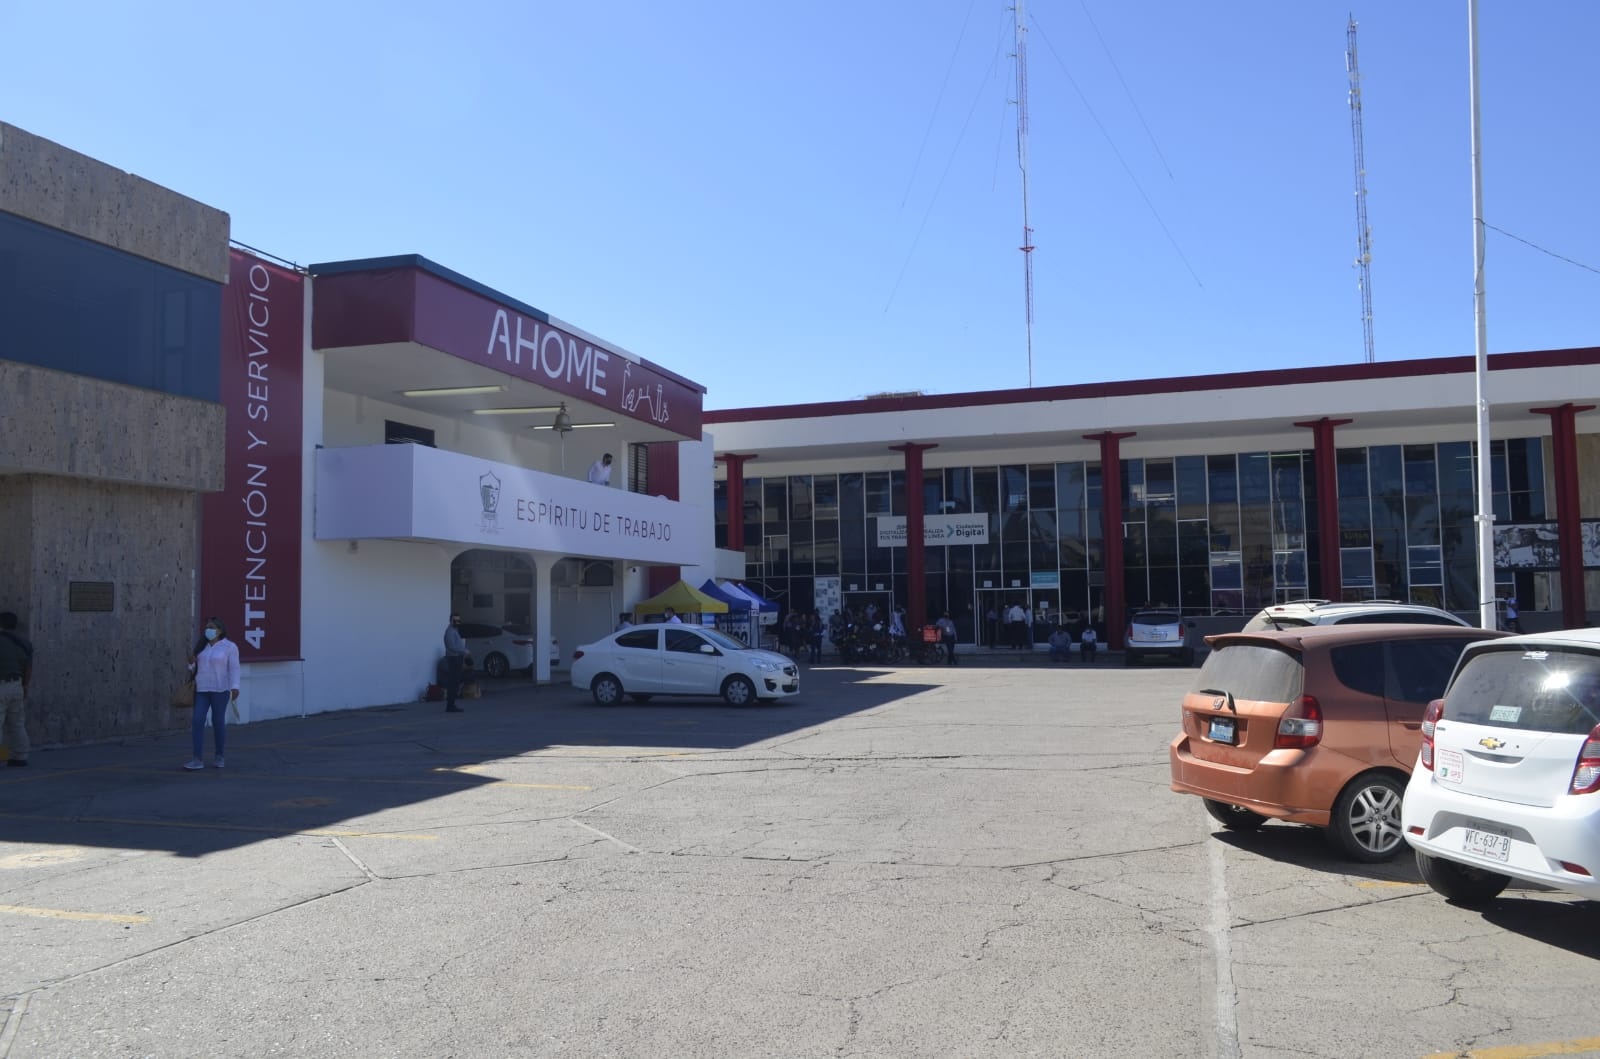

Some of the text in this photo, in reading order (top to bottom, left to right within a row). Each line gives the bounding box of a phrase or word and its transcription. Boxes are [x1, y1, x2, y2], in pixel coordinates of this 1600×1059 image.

[487, 309, 609, 396] AHOME
[245, 264, 270, 649] 4TENCIÓN Y SERVICIO
[516, 498, 587, 530] ESPÍRITU
[593, 512, 610, 533] DE
[617, 516, 672, 541] TRABAJO
[956, 529, 985, 537] Digital
